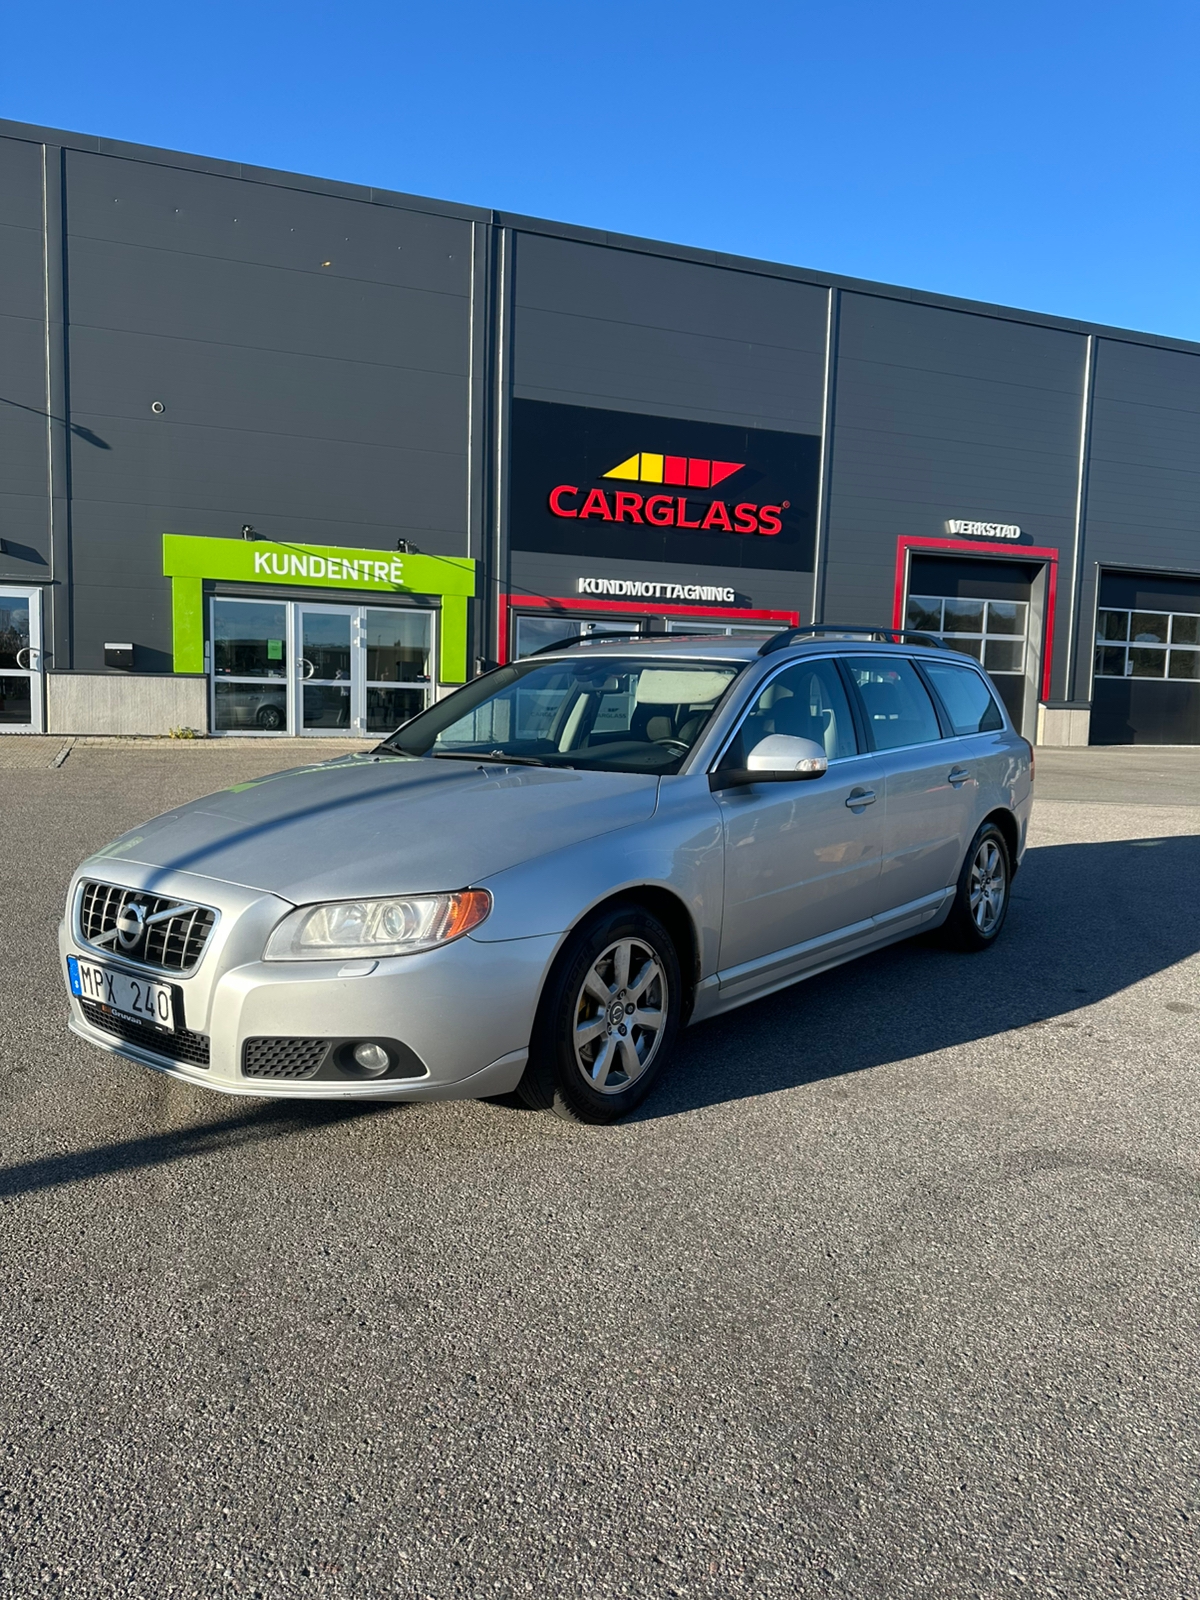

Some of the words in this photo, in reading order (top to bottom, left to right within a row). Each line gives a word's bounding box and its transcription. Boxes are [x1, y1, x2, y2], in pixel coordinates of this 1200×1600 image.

[549, 484, 782, 535] CARGLASS
[948, 519, 1021, 539] VERKSTAD
[254, 551, 404, 584] KUNDENTRÈ
[578, 577, 735, 602] KUNDMOTTAGNING
[81, 965, 117, 1005] MPX
[130, 981, 169, 1021] 240
[111, 1008, 142, 1025] Gruvan
